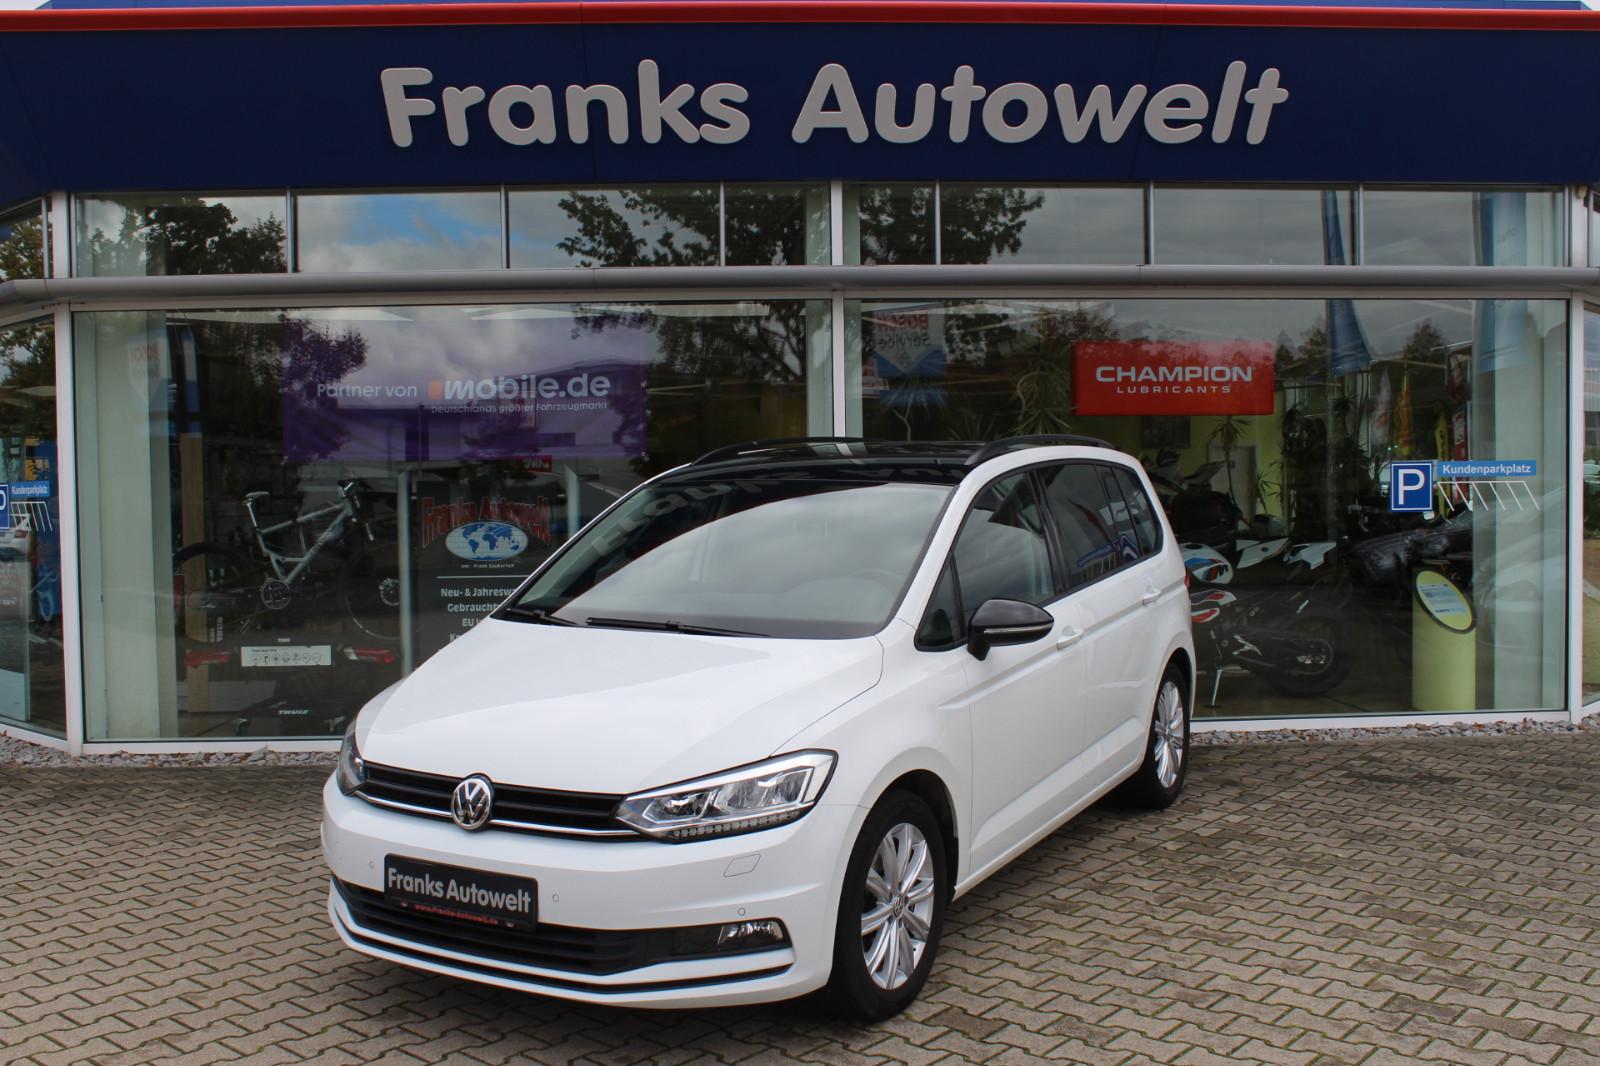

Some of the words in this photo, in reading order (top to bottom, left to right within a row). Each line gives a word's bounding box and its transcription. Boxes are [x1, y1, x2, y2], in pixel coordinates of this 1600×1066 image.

[380, 59, 750, 148] Franks
[791, 60, 1289, 146] Autowelt
[1095, 365, 1253, 382] CHAMPION
[317, 383, 382, 398] Partner
[385, 385, 418, 398] von
[444, 373, 611, 400] mobile.de
[1116, 385, 1232, 394] LUBRICANTS
[1442, 463, 1532, 475] Kundenparkplatz
[1398, 468, 1426, 505] P
[440, 587, 463, 598] Neu-
[464, 587, 472, 598] &
[472, 587, 516, 598] Jahresw
[447, 603, 499, 613] Gebraucht
[462, 618, 475, 627] EU
[387, 866, 444, 899] Franks
[446, 879, 532, 914] Autowelt
